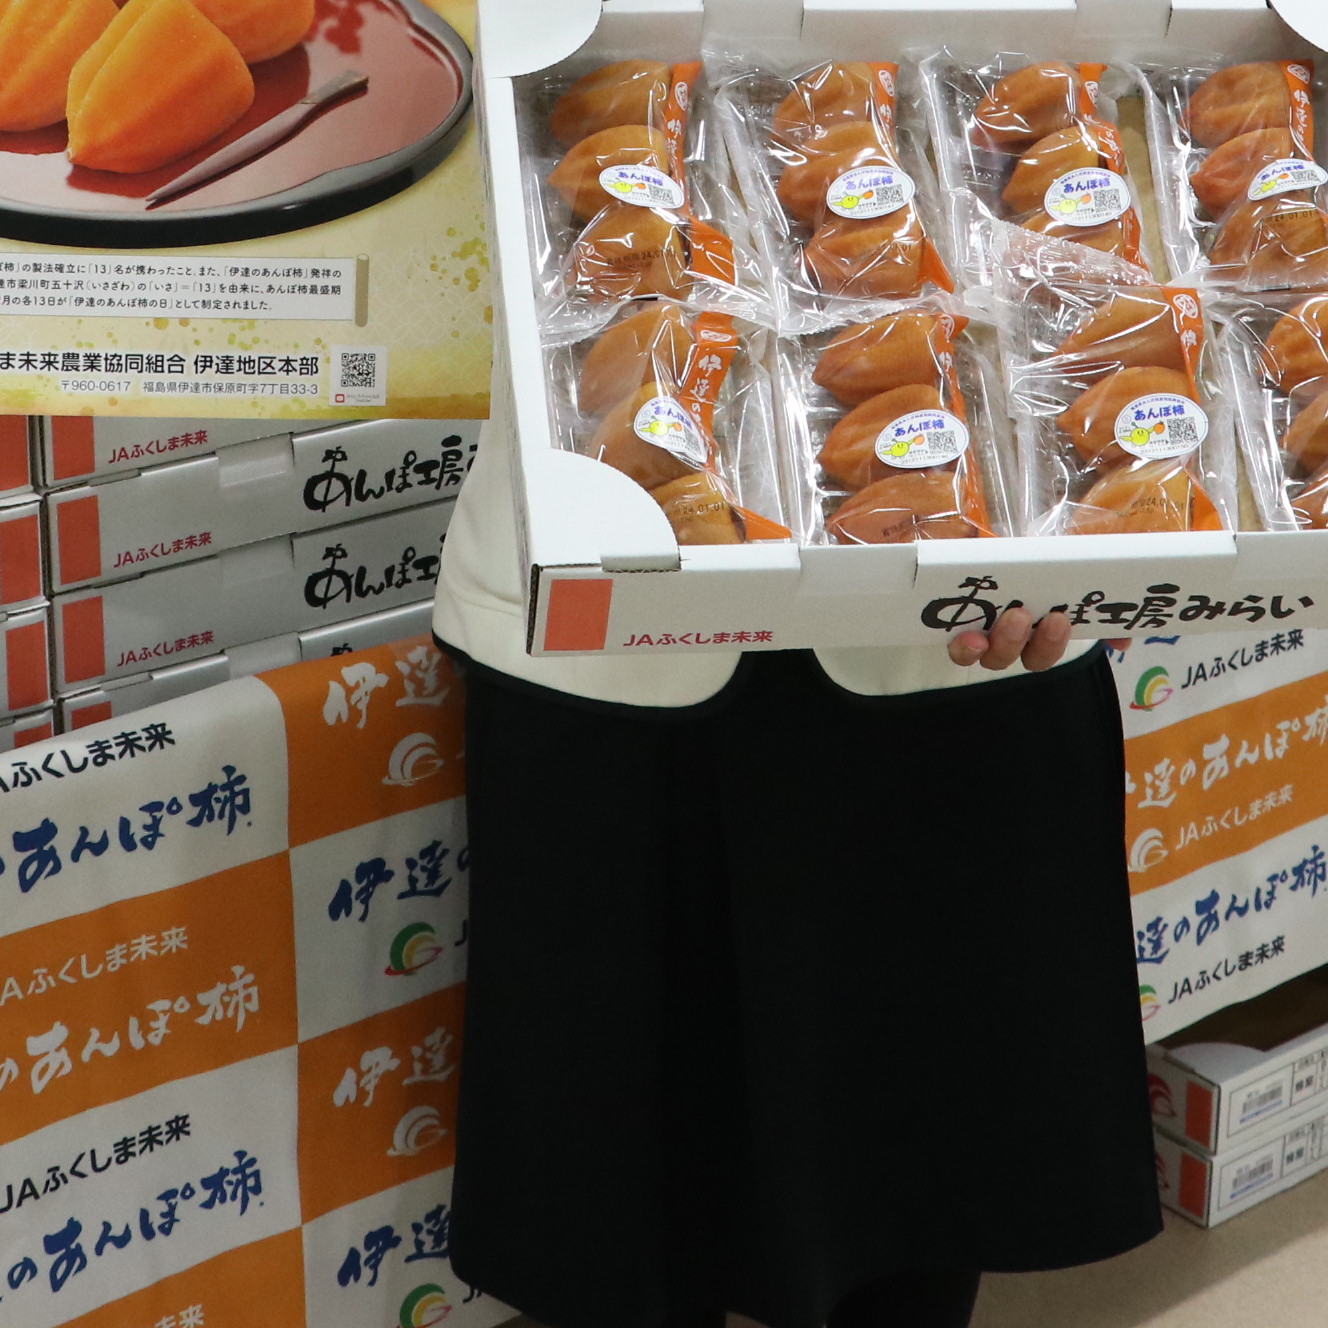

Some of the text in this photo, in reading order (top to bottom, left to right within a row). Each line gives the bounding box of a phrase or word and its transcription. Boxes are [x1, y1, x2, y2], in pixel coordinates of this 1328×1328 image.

[1063, 176, 1112, 193] あんぽ柿
[193, 353, 320, 377] 伊達地区本部
[60, 379, 319, 396] 〒960-0617 福島県伊達市保原町字7丁目33-3
[893, 418, 946, 438] あんぽ柿
[1134, 404, 1186, 421] あんぽ柿
[107, 429, 209, 465] JAふくしま未来
[303, 435, 480, 513] あんぽ工房
[113, 531, 213, 569] JAふくしま未来
[303, 542, 446, 611] あんぽ工
[920, 575, 1315, 633] あぽ工房みらい
[116, 630, 215, 668] JAふくしま未来
[623, 628, 773, 648] JAふくしま未来
[1181, 628, 1305, 690] JAふくしま未来
[1175, 784, 1294, 852] JAふくしま未来
[1136, 844, 1328, 965] 達のあんぽ柿
[1168, 935, 1286, 1005] JAふくしま未来
